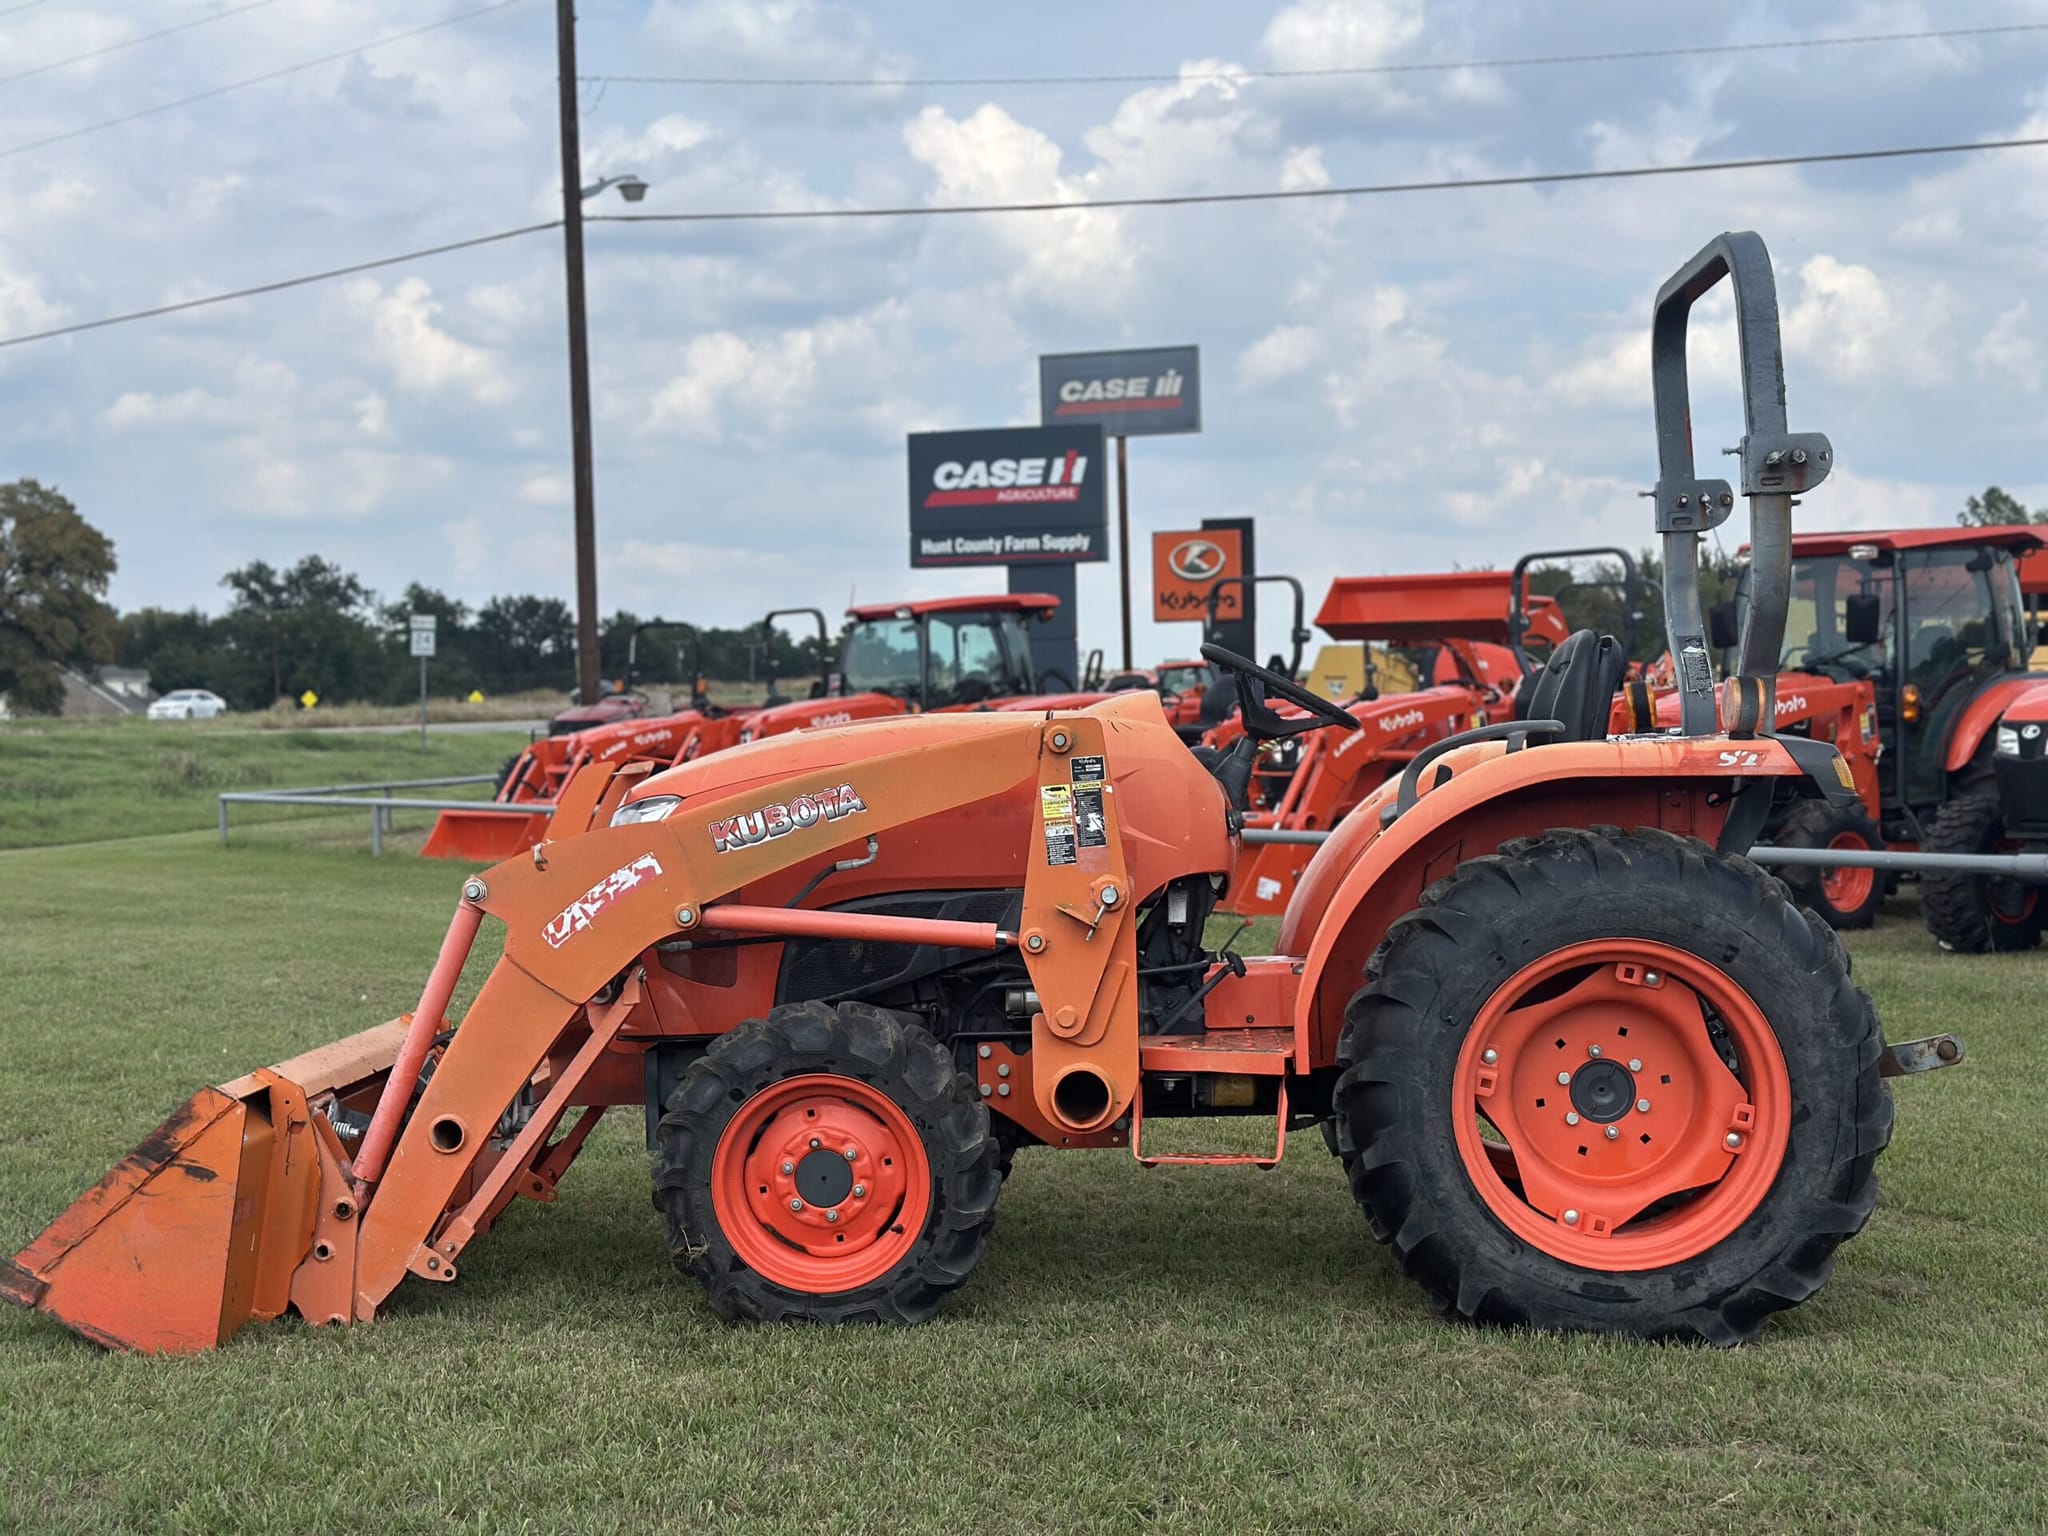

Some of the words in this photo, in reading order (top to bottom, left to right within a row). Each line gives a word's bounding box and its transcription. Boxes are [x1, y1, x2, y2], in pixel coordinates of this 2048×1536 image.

[1060, 377, 1150, 402] CASE
[933, 458, 1047, 490] CASE
[997, 487, 1076, 502] AGRICULTURE
[921, 539, 953, 555] Hunt
[954, 537, 1002, 555] County
[1004, 535, 1040, 551] Farm
[1042, 533, 1090, 552] Supply
[1160, 591, 1236, 609] Kuba
[1379, 709, 1424, 732] Kubota
[709, 783, 868, 854] KUBOTA
